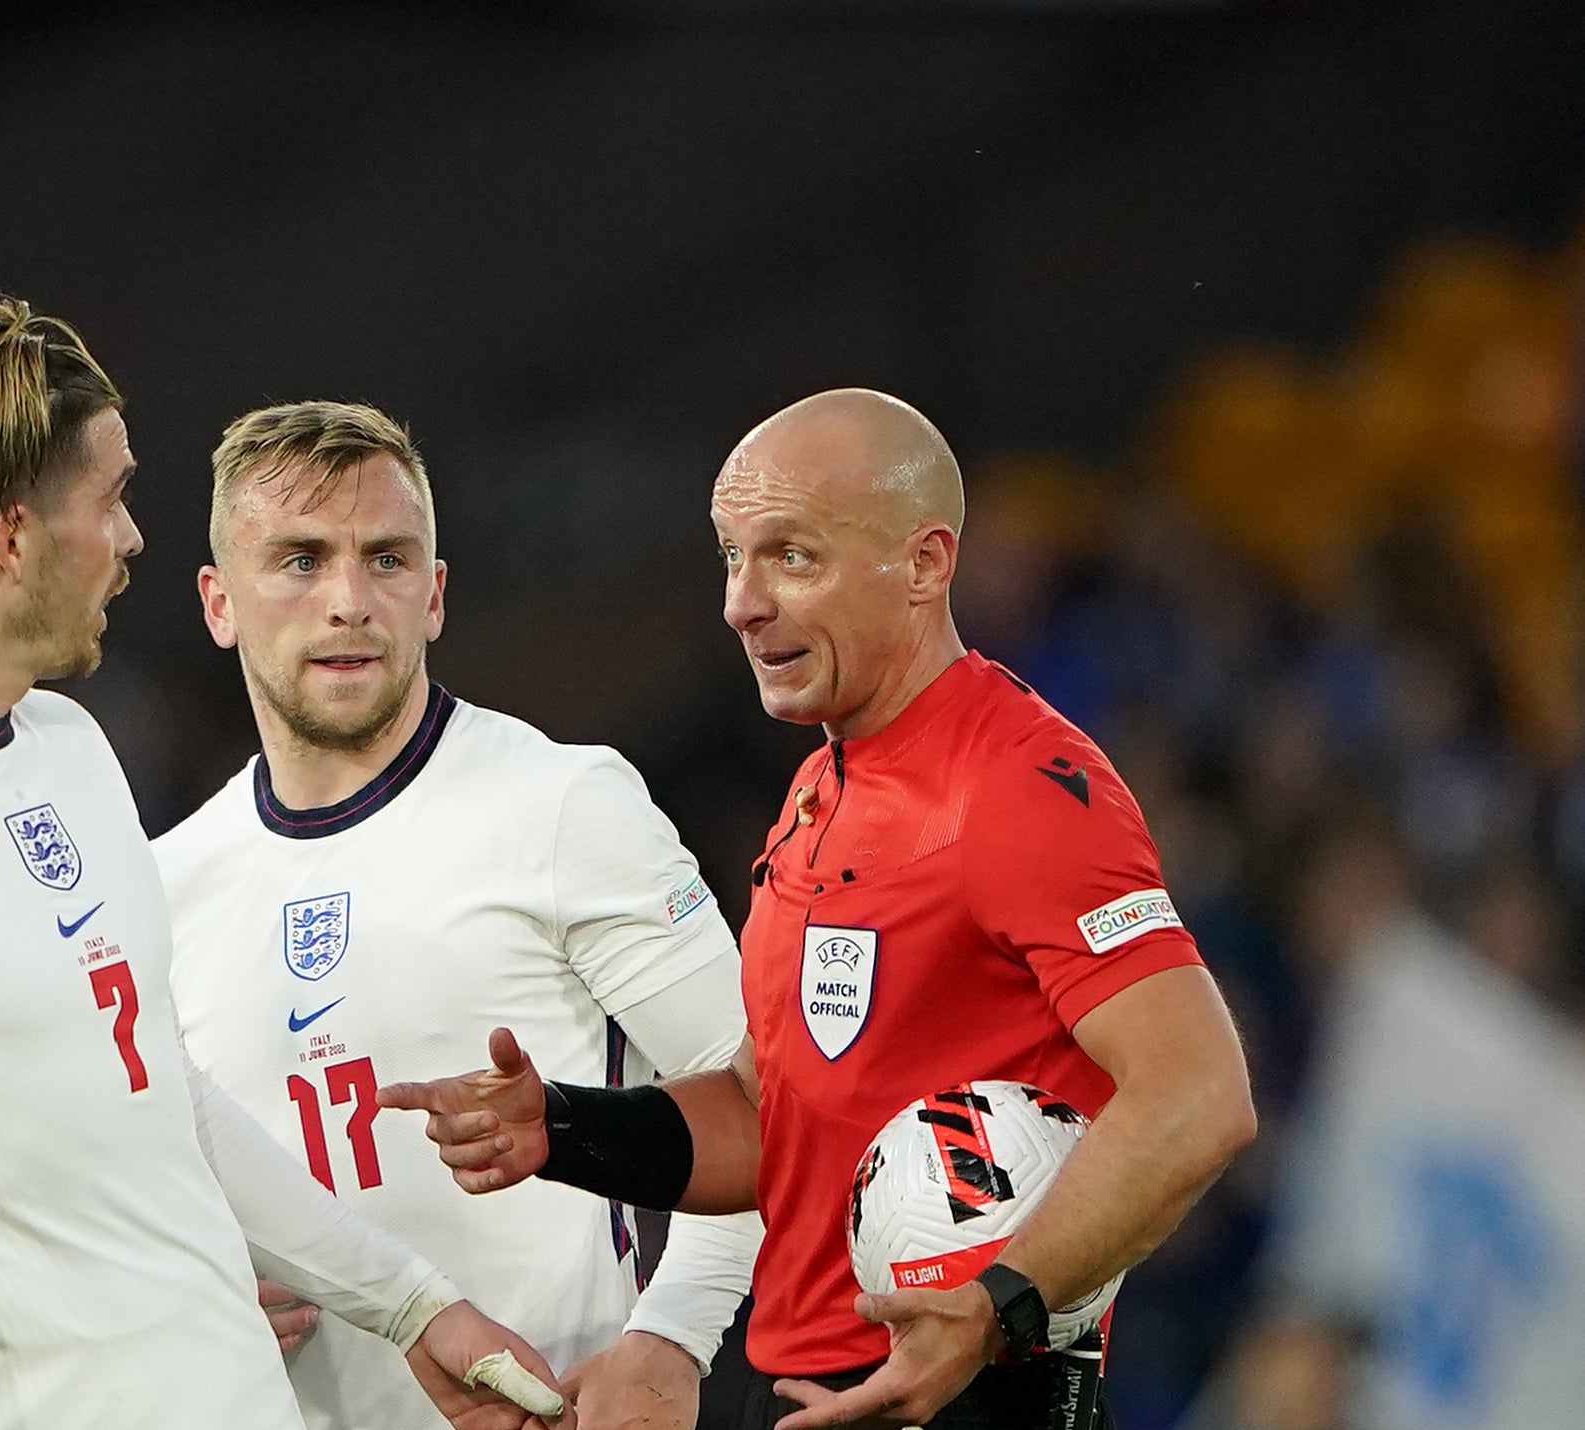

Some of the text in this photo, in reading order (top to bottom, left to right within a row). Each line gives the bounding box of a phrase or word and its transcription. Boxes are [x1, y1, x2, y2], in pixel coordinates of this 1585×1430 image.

[1083, 909, 1109, 927] UEFA
[84, 936, 106, 950] ITALY
[87, 949, 105, 964] JUNE
[817, 942, 860, 967] UEFA
[816, 982, 857, 997] MATCH
[810, 1001, 860, 1018] OFFICIAL
[88, 960, 149, 1093] 7
[310, 1034, 331, 1048] ITALY
[308, 1048, 328, 1061] JUNE
[329, 1043, 347, 1056] 2022
[287, 1056, 383, 1197] 17
[904, 1264, 945, 1285] FLIGHT
